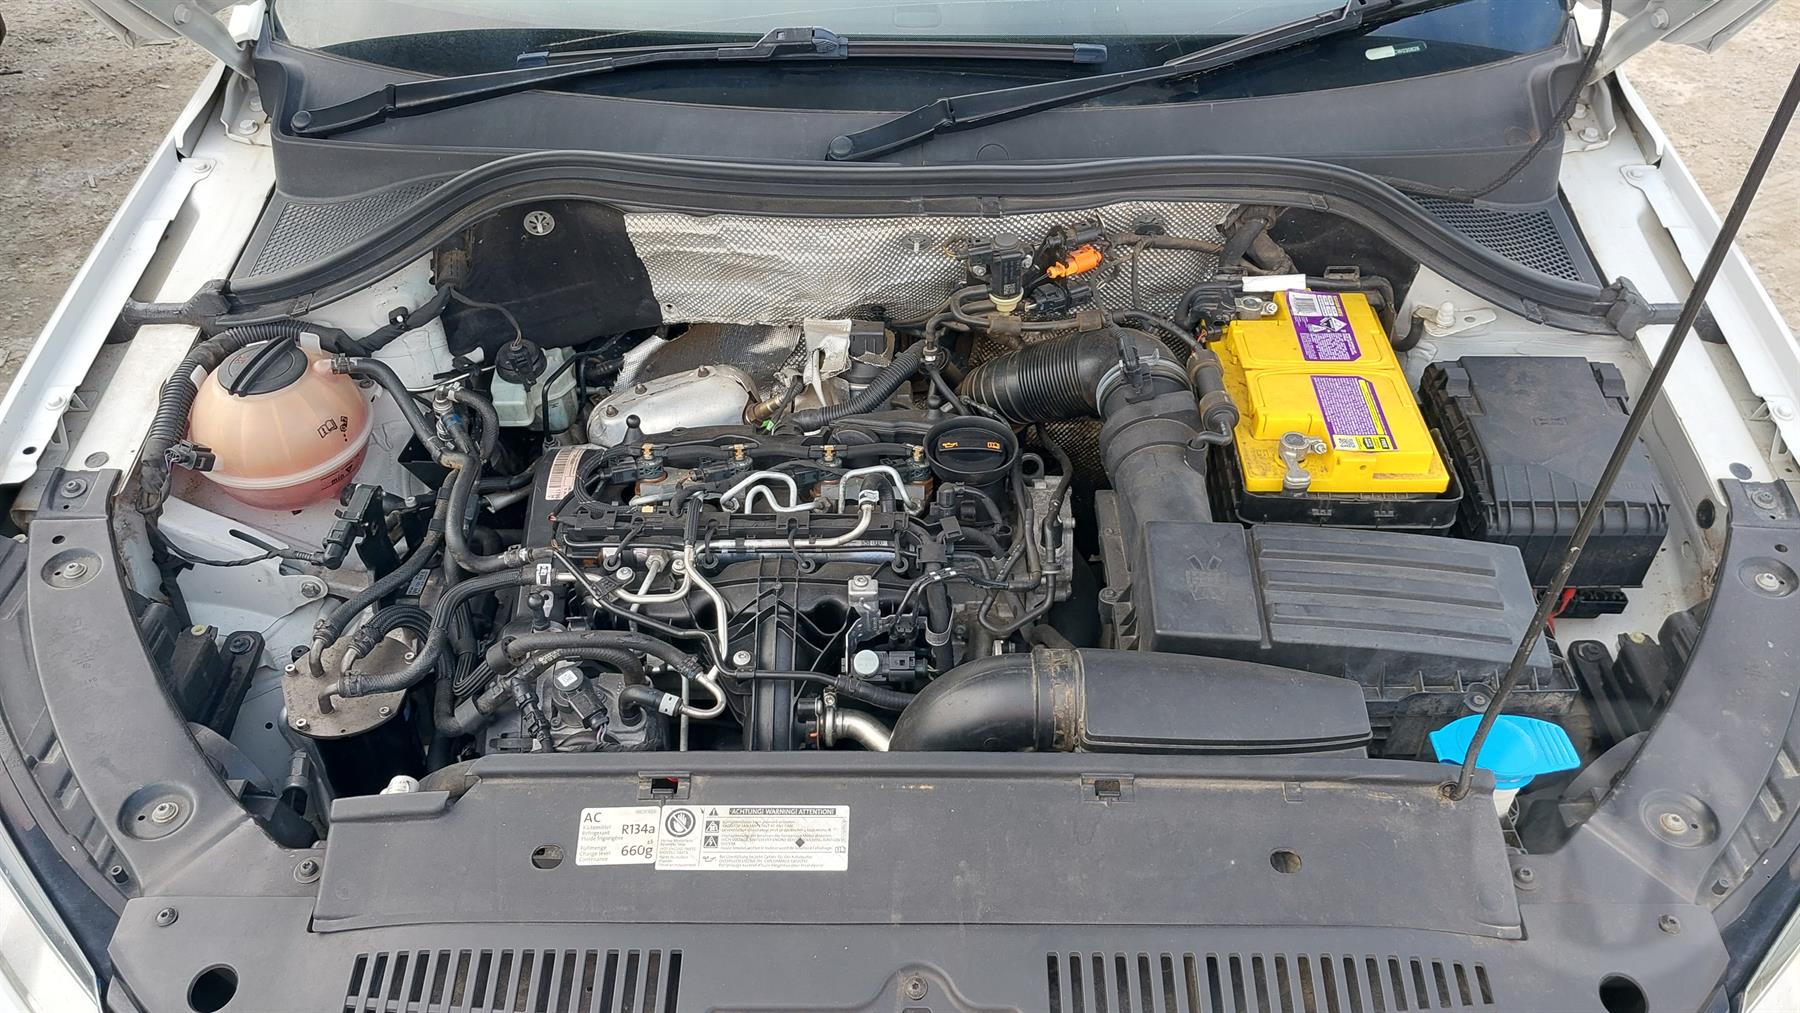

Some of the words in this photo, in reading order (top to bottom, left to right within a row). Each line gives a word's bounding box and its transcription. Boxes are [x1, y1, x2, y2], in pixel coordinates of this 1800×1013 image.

[331, 474, 345, 485] min
[584, 812, 602, 823] AC
[622, 824, 655, 835] R134a
[621, 845, 653, 859] 660g
